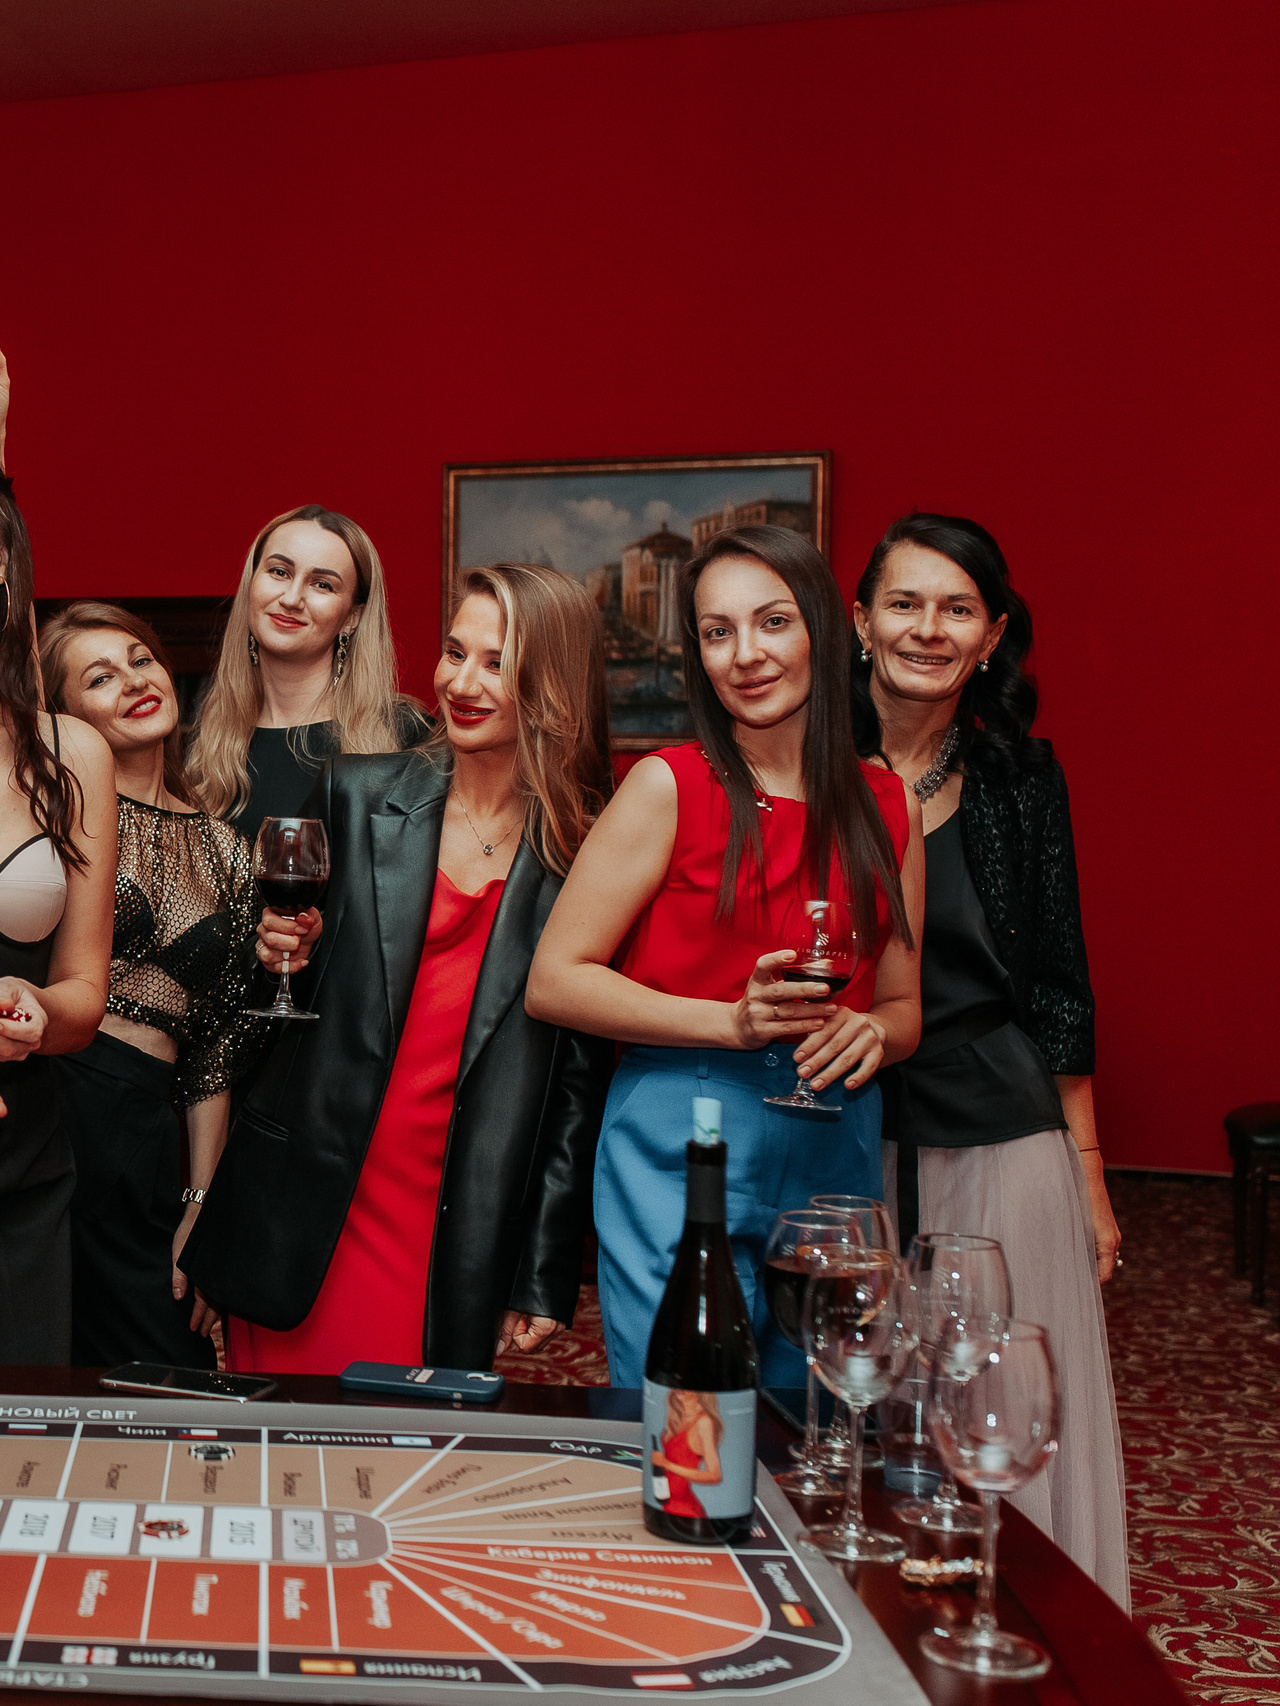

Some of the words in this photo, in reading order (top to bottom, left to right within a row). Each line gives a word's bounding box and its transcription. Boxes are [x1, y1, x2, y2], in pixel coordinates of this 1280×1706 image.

[86, 1407, 138, 1421] СВЕТ
[116, 1425, 168, 1438] Чили
[282, 1431, 389, 1446] Аргентина
[550, 1439, 602, 1456] ЮАР
[486, 1545, 590, 1562] Каберне
[594, 1549, 713, 1566] Совиньон
[128, 1651, 216, 1670] Грузия
[362, 1660, 482, 1682] Испания
